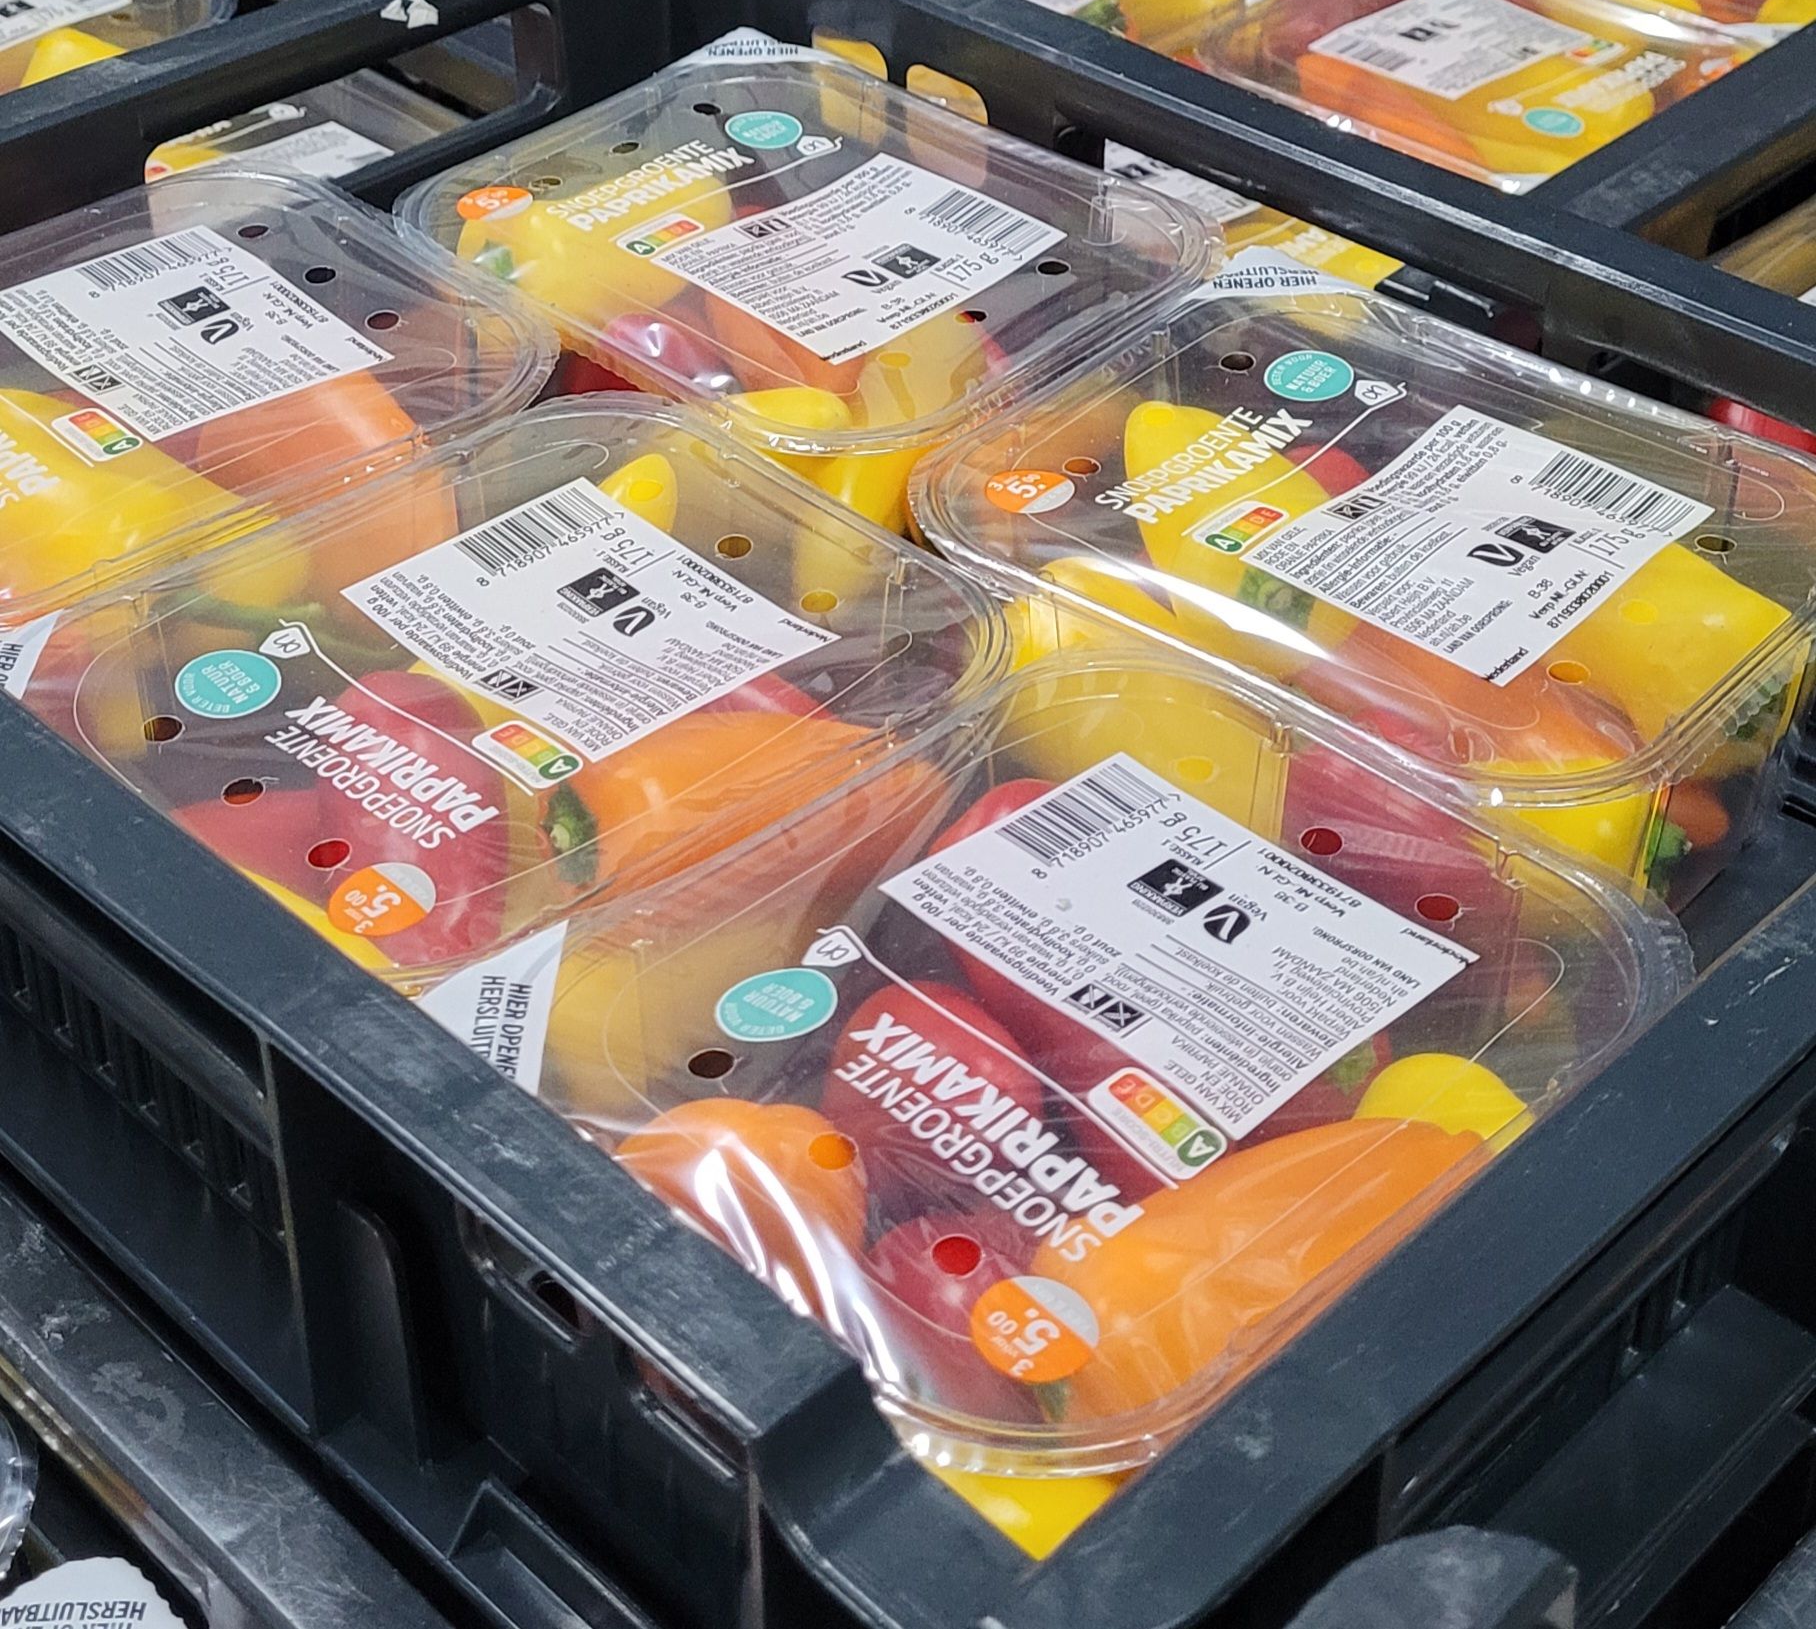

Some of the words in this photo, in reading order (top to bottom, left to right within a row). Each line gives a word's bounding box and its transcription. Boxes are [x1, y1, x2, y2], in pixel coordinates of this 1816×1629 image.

[543, 139, 718, 219] SNOEPGROENTE
[564, 145, 761, 232] PAPRIKAMIX
[205, 256, 231, 267] g
[208, 263, 251, 285] 175
[943, 258, 985, 282] 175
[975, 251, 1002, 265] g
[1213, 277, 1275, 289] OPENEN
[1280, 275, 1317, 287] HIER
[1283, 359, 1330, 391] NATUUR
[1091, 406, 1267, 511] SNOEPGROENTE
[1121, 407, 1317, 526] PAPRIKAMIX
[985, 480, 1006, 492] 3
[598, 526, 628, 542] g
[1212, 536, 1237, 550] A
[1587, 530, 1630, 556] 175
[1619, 526, 1646, 540] g
[472, 575, 492, 587] 8
[493, 544, 554, 577] 718907
[554, 515, 614, 547] 465977
[606, 537, 655, 565] 175
[1506, 554, 1543, 578] Vegan
[367, 584, 401, 607] vetten
[557, 586, 602, 615] VERPAKKING
[638, 596, 675, 618] Vegan
[1431, 577, 1475, 610] ZAANDAM
[370, 603, 392, 618] 100
[386, 616, 410, 630] per
[439, 612, 496, 652] koolhydraten
[777, 618, 832, 642] Nederland
[401, 628, 475, 679] Voedingswaarde
[449, 649, 488, 673] energie
[195, 663, 252, 704] NATUUR
[215, 658, 255, 686] BOER
[282, 694, 504, 832] PAPRIKAMIX
[541, 757, 575, 777] A
[262, 723, 459, 850] SNOEPGROENTE
[1157, 809, 1189, 829] g
[1028, 866, 1049, 880] 8
[1049, 830, 1112, 869] 718907
[1109, 797, 1171, 834] 465977
[1172, 823, 1229, 857] 175
[1165, 842, 1205, 866] KLASSE:
[909, 877, 950, 905] vetten
[931, 862, 977, 892] waarvan
[969, 873, 995, 889] 0,8
[918, 900, 944, 917] 100
[989, 886, 1040, 919] eiwitten
[1128, 881, 1186, 915] VERPAKKING
[1225, 892, 1272, 921] Vegan
[350, 918, 376, 934] 3
[941, 914, 969, 931] per
[971, 920, 990, 932] 24
[1001, 909, 1076, 959] koolhydraten
[992, 934, 1011, 947] kJ
[1006, 944, 1027, 958] 99
[1066, 937, 1110, 965] suikers
[1090, 938, 1122, 958] zout
[1399, 927, 1473, 965] Nederland
[961, 929, 1061, 996] Voedingswaarde
[1023, 954, 1073, 988] energie
[1270, 945, 1335, 982] ZAANDAM
[1371, 957, 1394, 972] VAN
[1331, 977, 1356, 993] MA
[1332, 965, 1398, 1007] Nederland
[1390, 968, 1421, 988] LAND
[503, 983, 533, 1020] HIER
[740, 989, 805, 1023] NATUUR
[759, 981, 805, 1005] BOER
[1236, 982, 1278, 1008] buiten
[1289, 964, 1376, 1023] Provincialeweg
[1293, 981, 1329, 1007] Heijn
[1351, 990, 1384, 1014] 1506
[1157, 1007, 1203, 1036] paprika
[1185, 989, 1309, 1071] Allergie-informatie:
[1246, 1008, 1277, 1029] voor
[1274, 1005, 1339, 1048] Bewaren:
[1303, 1005, 1354, 1038] Verpakt
[1323, 1003, 1365, 1031] Albert
[496, 1023, 524, 1079] OPENE
[1168, 1034, 1220, 1069] PAPRIKA
[1272, 1025, 1324, 1059] Wassen
[1198, 1032, 1282, 1093] Ingrediënten:
[1254, 1052, 1295, 1081] oranje
[1198, 1069, 1222, 1087] EN
[1214, 1065, 1266, 1105] ORANJE
[1191, 1082, 1223, 1106] VAN
[1216, 1083, 1255, 1114] RODE
[846, 1009, 1148, 1240] PAPRIKAMIX
[1215, 1101, 1244, 1123] MIX
[831, 1050, 1105, 1265] SNOEPGROENTE
[1177, 1133, 1218, 1163] A
[1007, 1355, 1036, 1379] 3
[0, 1601, 147, 1626] HERSLUITBAA
